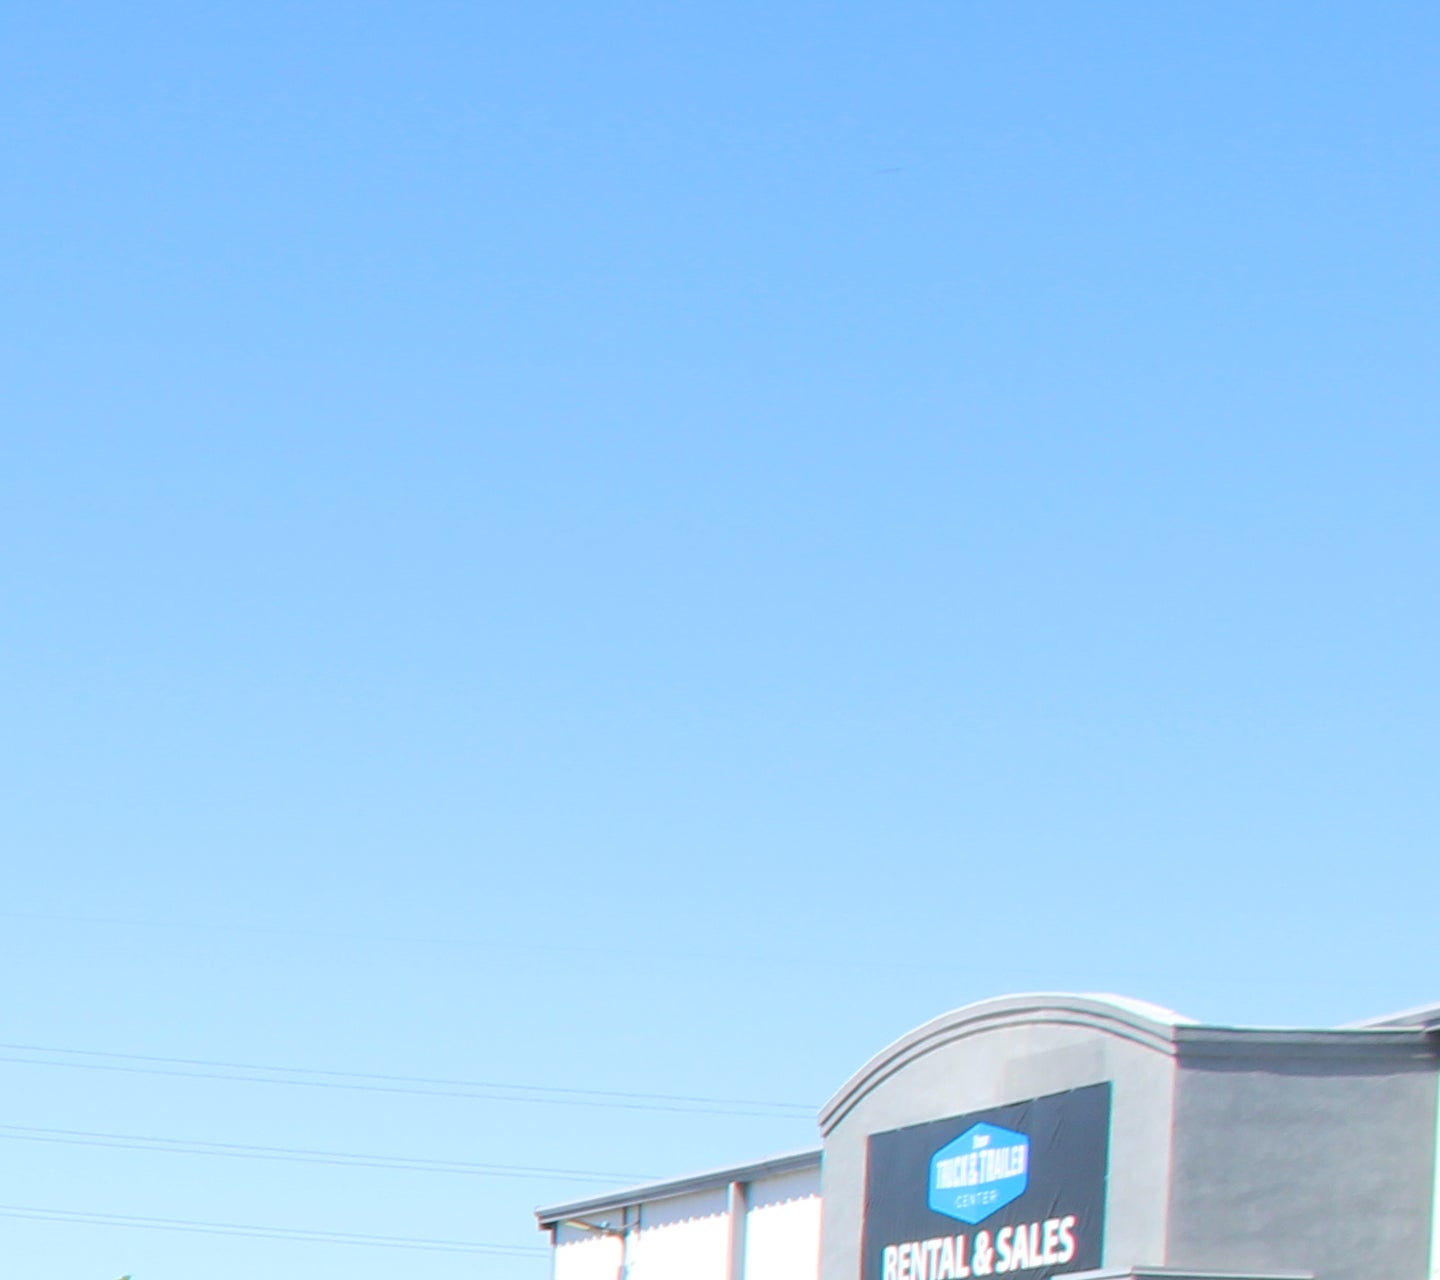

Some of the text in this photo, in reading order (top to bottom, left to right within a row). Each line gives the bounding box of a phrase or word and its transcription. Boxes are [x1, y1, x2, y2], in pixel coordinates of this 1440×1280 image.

[954, 1189, 999, 1209] CENTER
[973, 1229, 994, 1277] &
[995, 1214, 1078, 1274] SALES
